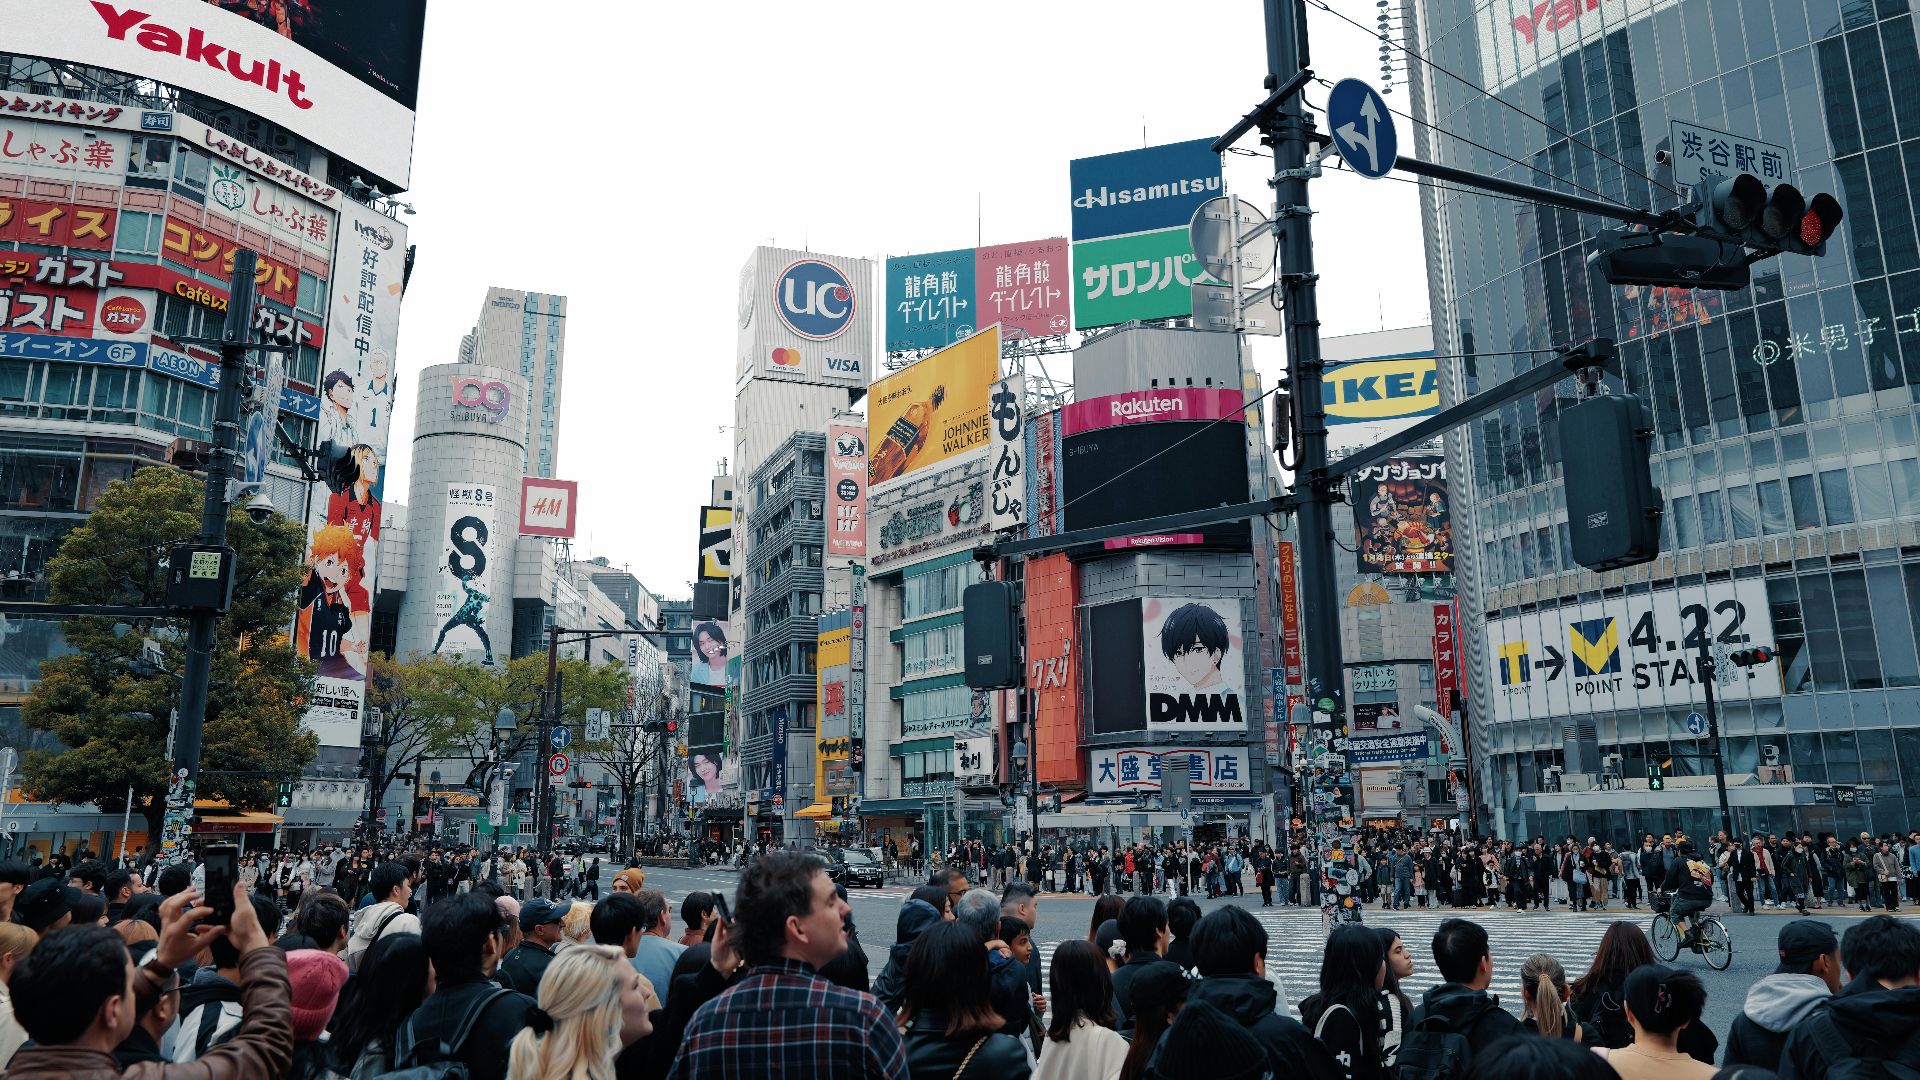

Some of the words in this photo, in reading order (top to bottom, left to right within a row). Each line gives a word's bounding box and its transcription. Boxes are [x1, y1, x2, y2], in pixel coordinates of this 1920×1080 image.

[89, 0, 314, 109] Yakult
[144, 115, 171, 127] 寿司
[3, 130, 115, 169] しゃぶ葉
[1682, 131, 1784, 180] 渋谷駅前
[206, 129, 337, 201] しゃぶしゃぶバイキング
[1074, 176, 1220, 208] Hisamitsu
[253, 187, 328, 241] しゃぶ葉
[35, 256, 123, 287] ガスト
[905, 271, 958, 299] 龍角散
[996, 260, 1050, 289] 龍角散
[106, 312, 141, 324] ガスト
[256, 307, 312, 344] ガスト
[110, 346, 132, 359] 6F
[158, 352, 200, 377] AEON
[826, 358, 860, 372] VISA
[447, 375, 511, 423] 109
[1111, 398, 1182, 417] Rakuten
[450, 410, 487, 422] SHIBUYA
[943, 413, 989, 441] JOHNNIE
[943, 428, 989, 454] WALKER
[991, 381, 1022, 521] もんじゃ
[532, 498, 562, 517] H&M
[1131, 537, 1154, 545] Rakuten
[1280, 545, 1295, 623] クスリのことなら
[1628, 600, 1750, 654] 4.22
[321, 630, 338, 657] 10
[1284, 629, 1300, 677] 三千里
[1354, 679, 1396, 690] クリニック
[1632, 655, 1756, 690] STAR
[1575, 678, 1622, 697] POINT
[1149, 692, 1243, 722] DMM
[904, 718, 969, 733] ジャスミンレディースクリニック
